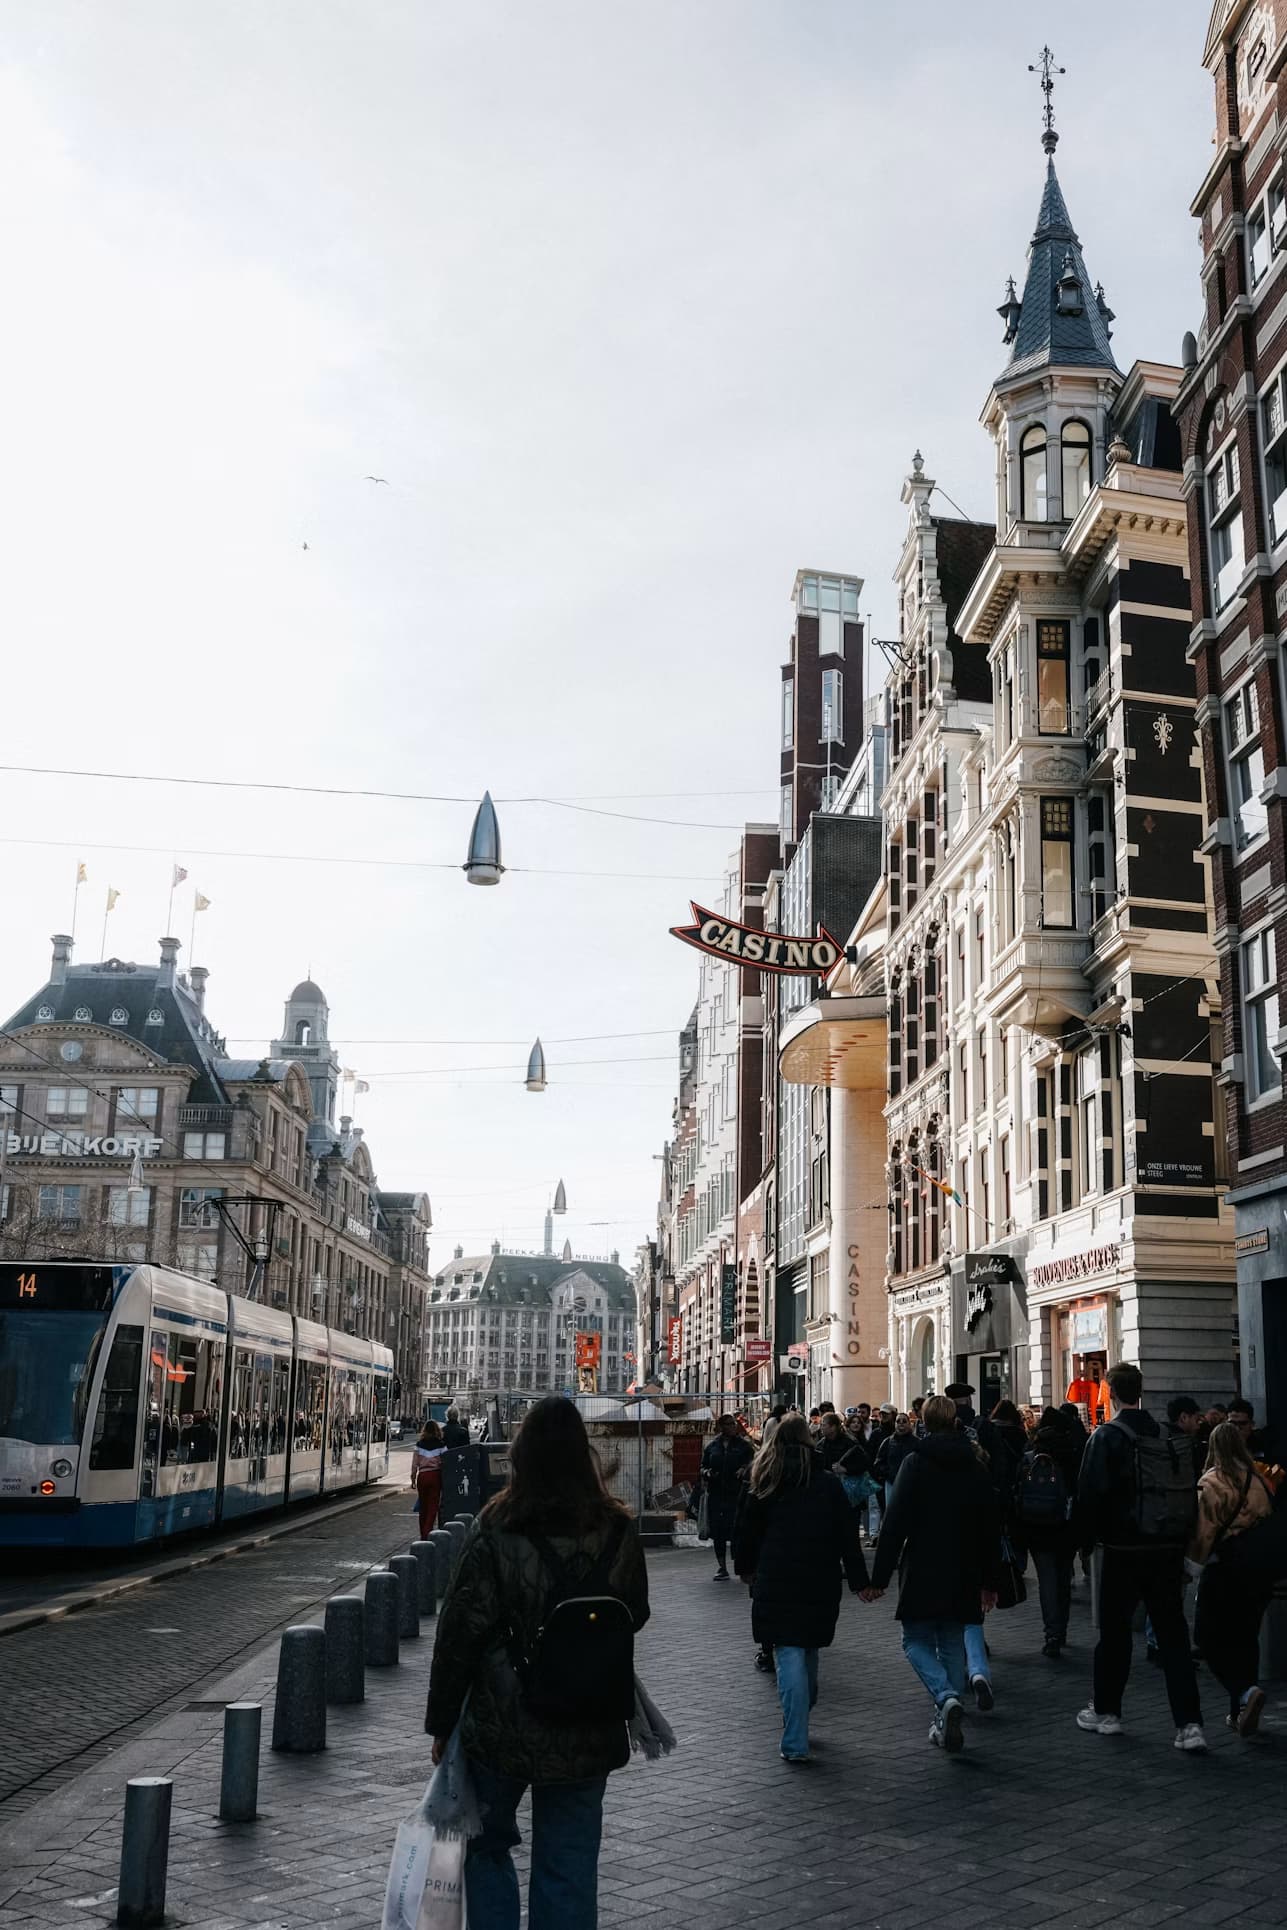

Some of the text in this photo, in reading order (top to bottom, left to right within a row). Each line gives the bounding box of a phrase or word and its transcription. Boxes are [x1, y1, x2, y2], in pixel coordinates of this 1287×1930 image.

[700, 919, 837, 967] CASINO
[1147, 1162, 1203, 1172] ONZE LIEVE VROUWE
[17, 1273, 37, 1297] 14
[723, 1273, 734, 1335] PRIMARK
[847, 1244, 860, 1355] CASINO
